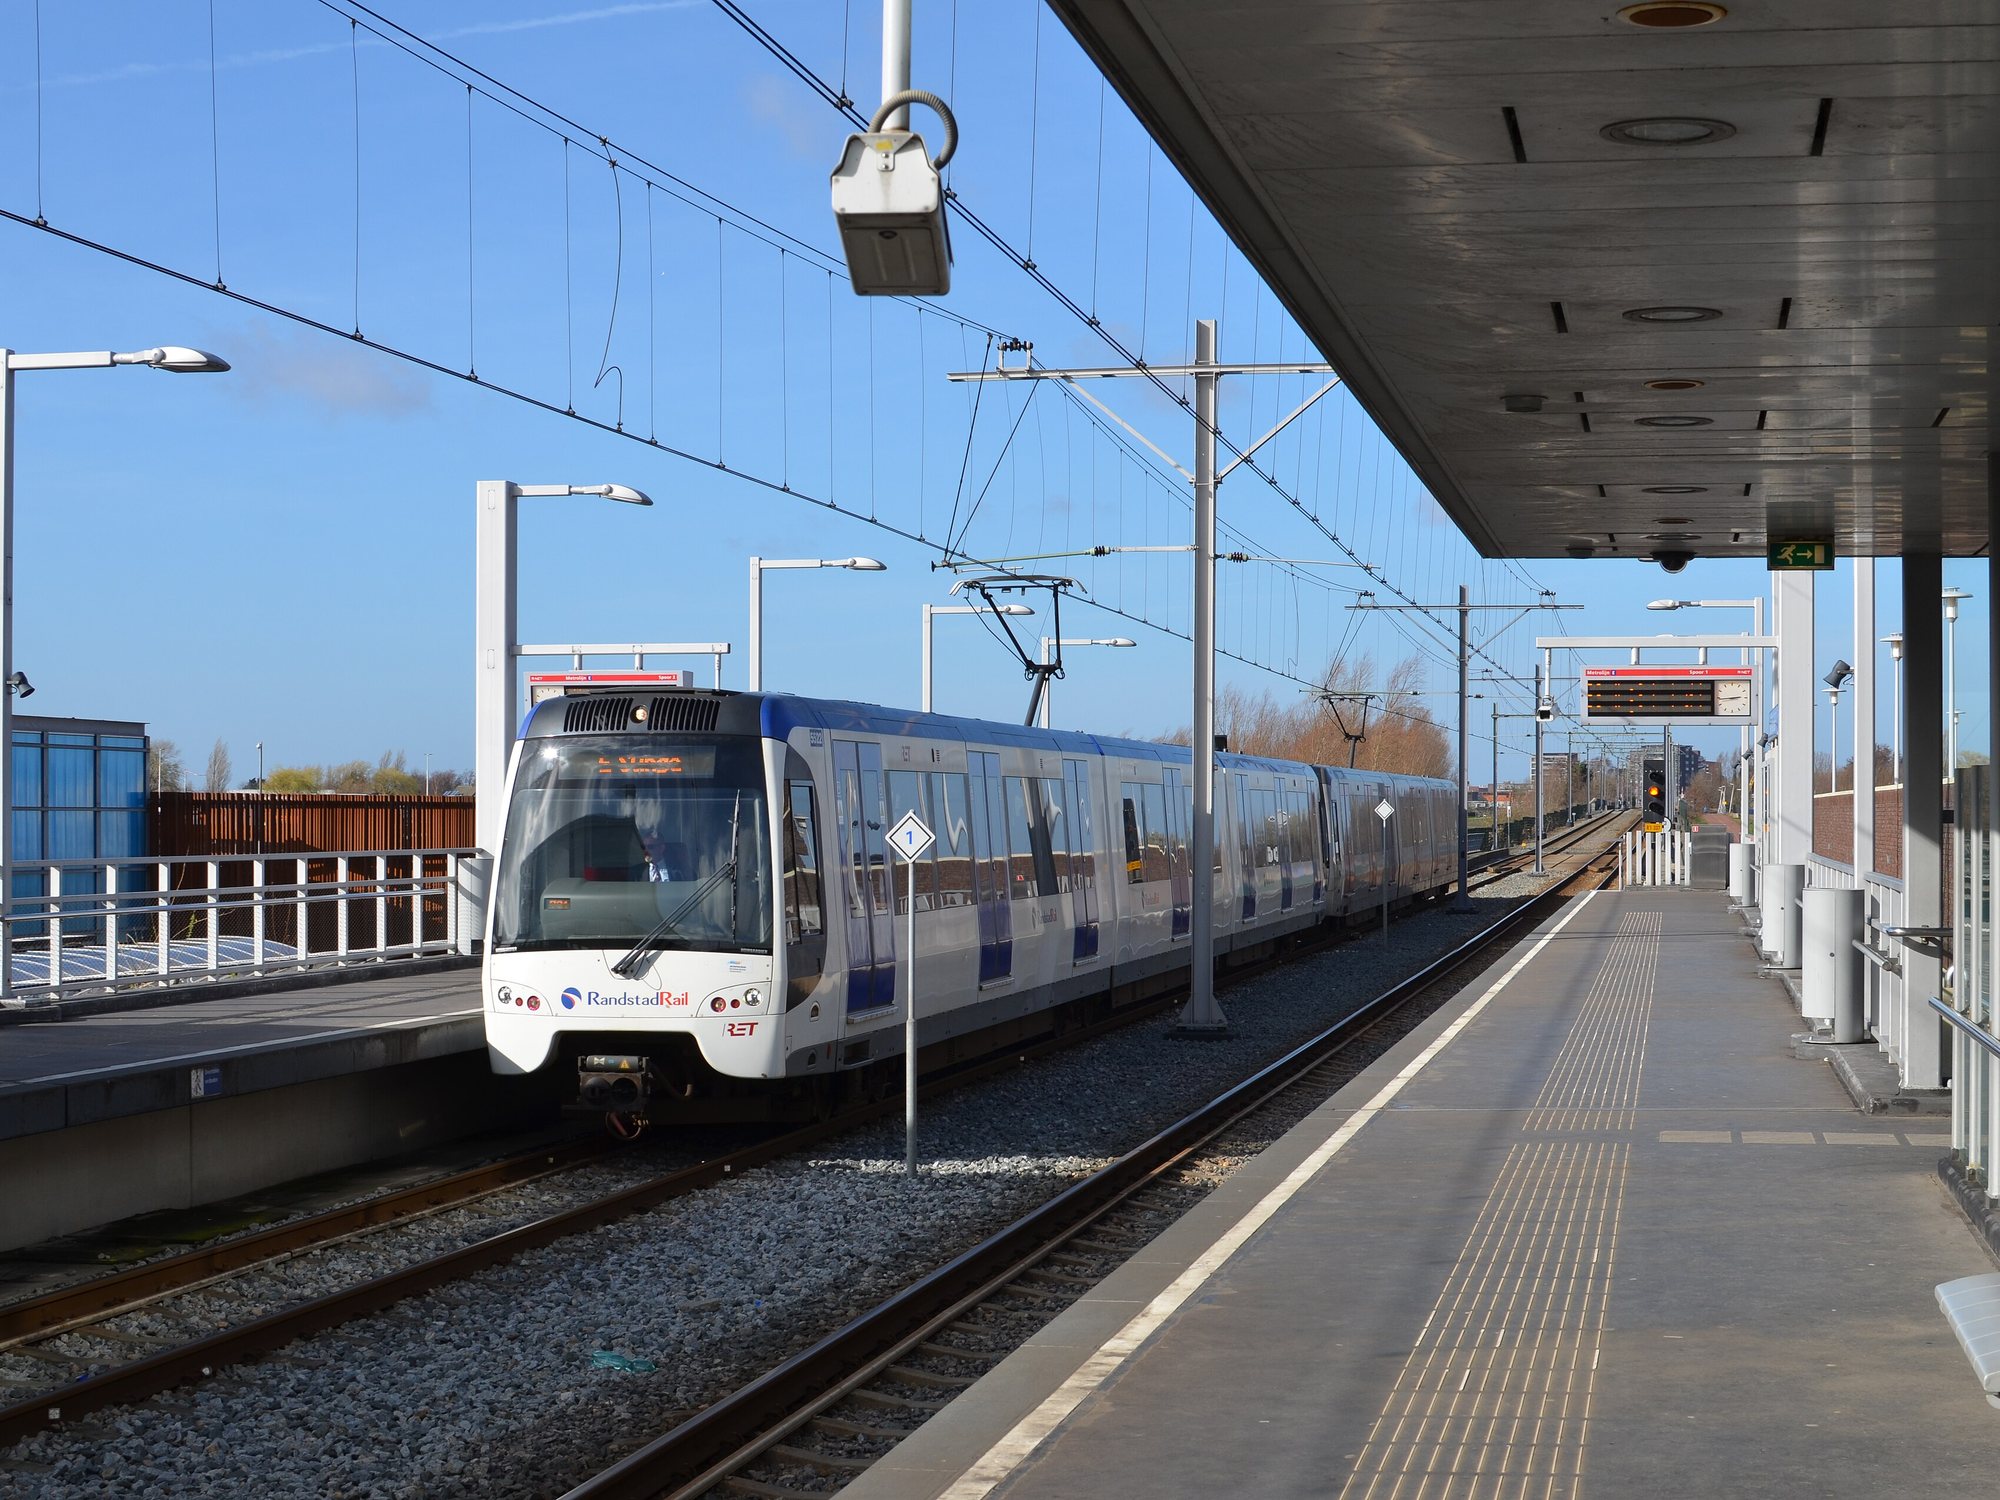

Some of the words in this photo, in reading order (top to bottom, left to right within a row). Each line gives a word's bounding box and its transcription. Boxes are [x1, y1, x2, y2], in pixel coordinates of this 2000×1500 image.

[905, 830, 913, 845] 1
[587, 991, 688, 1006] RandstadRail
[727, 1022, 759, 1037] RET
